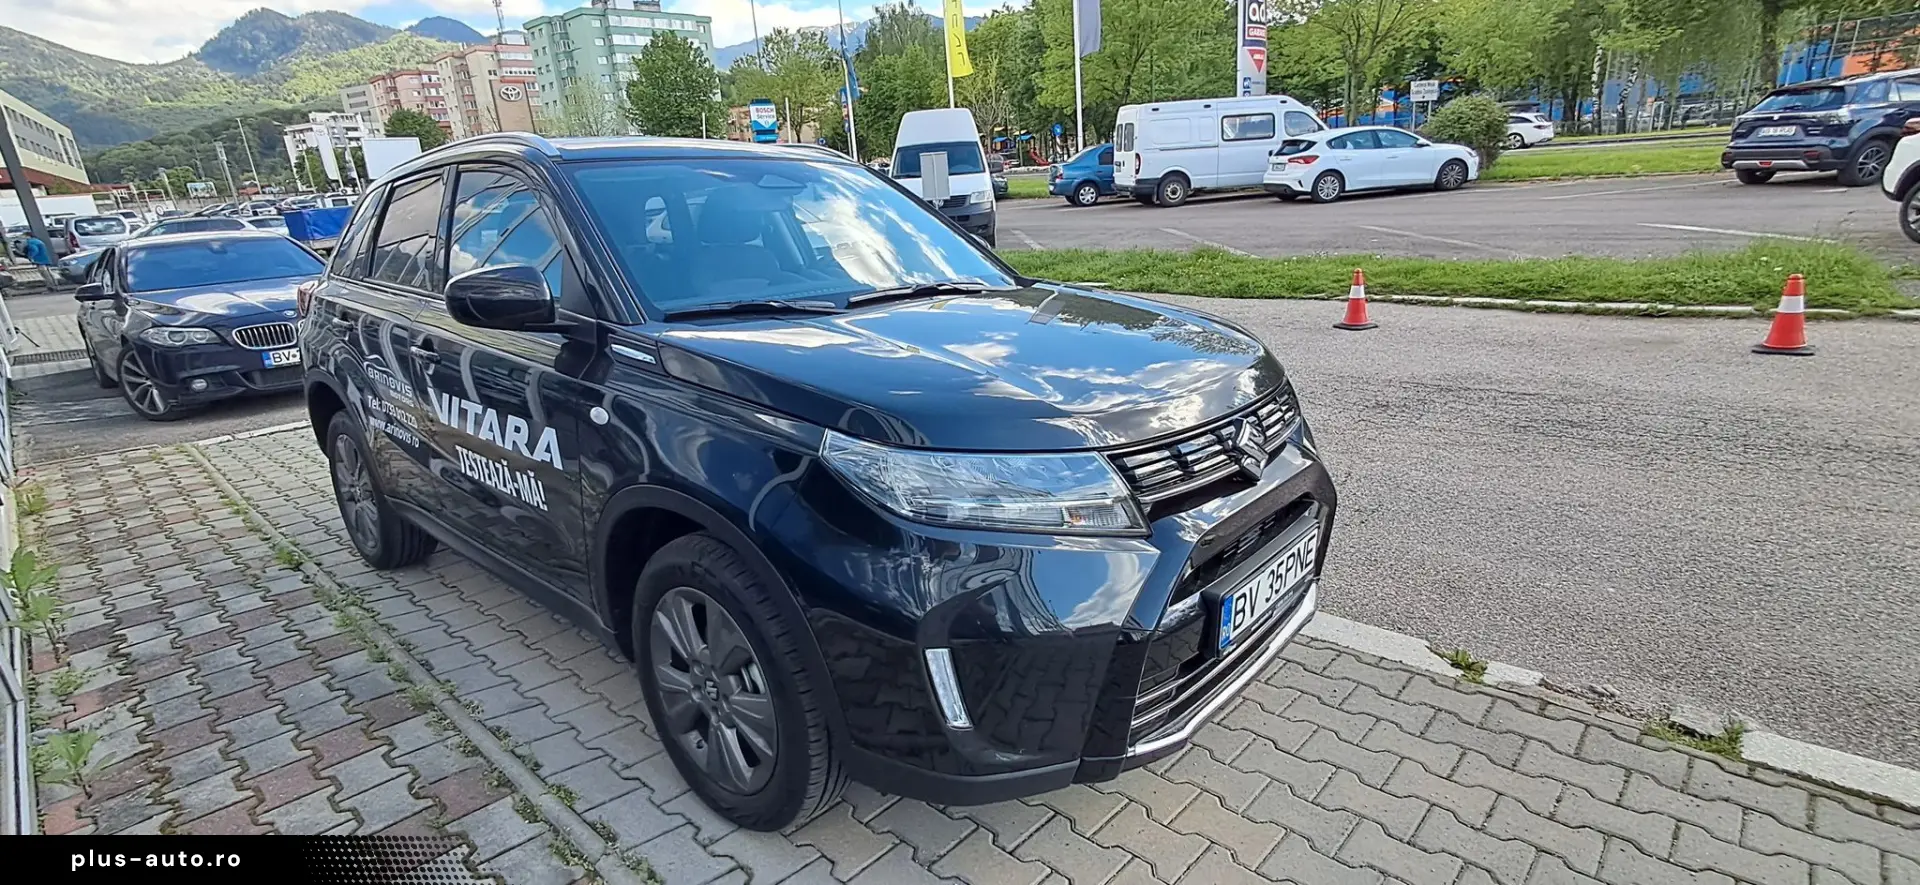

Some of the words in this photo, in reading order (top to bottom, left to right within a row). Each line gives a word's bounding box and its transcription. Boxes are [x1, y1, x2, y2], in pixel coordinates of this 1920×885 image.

[272, 351, 290, 363] BV
[367, 395, 380, 411] Tel:
[428, 388, 564, 471] VITARA
[455, 445, 549, 512] TESTEAZĂ-MĂ!
[1232, 580, 1261, 633] BV
